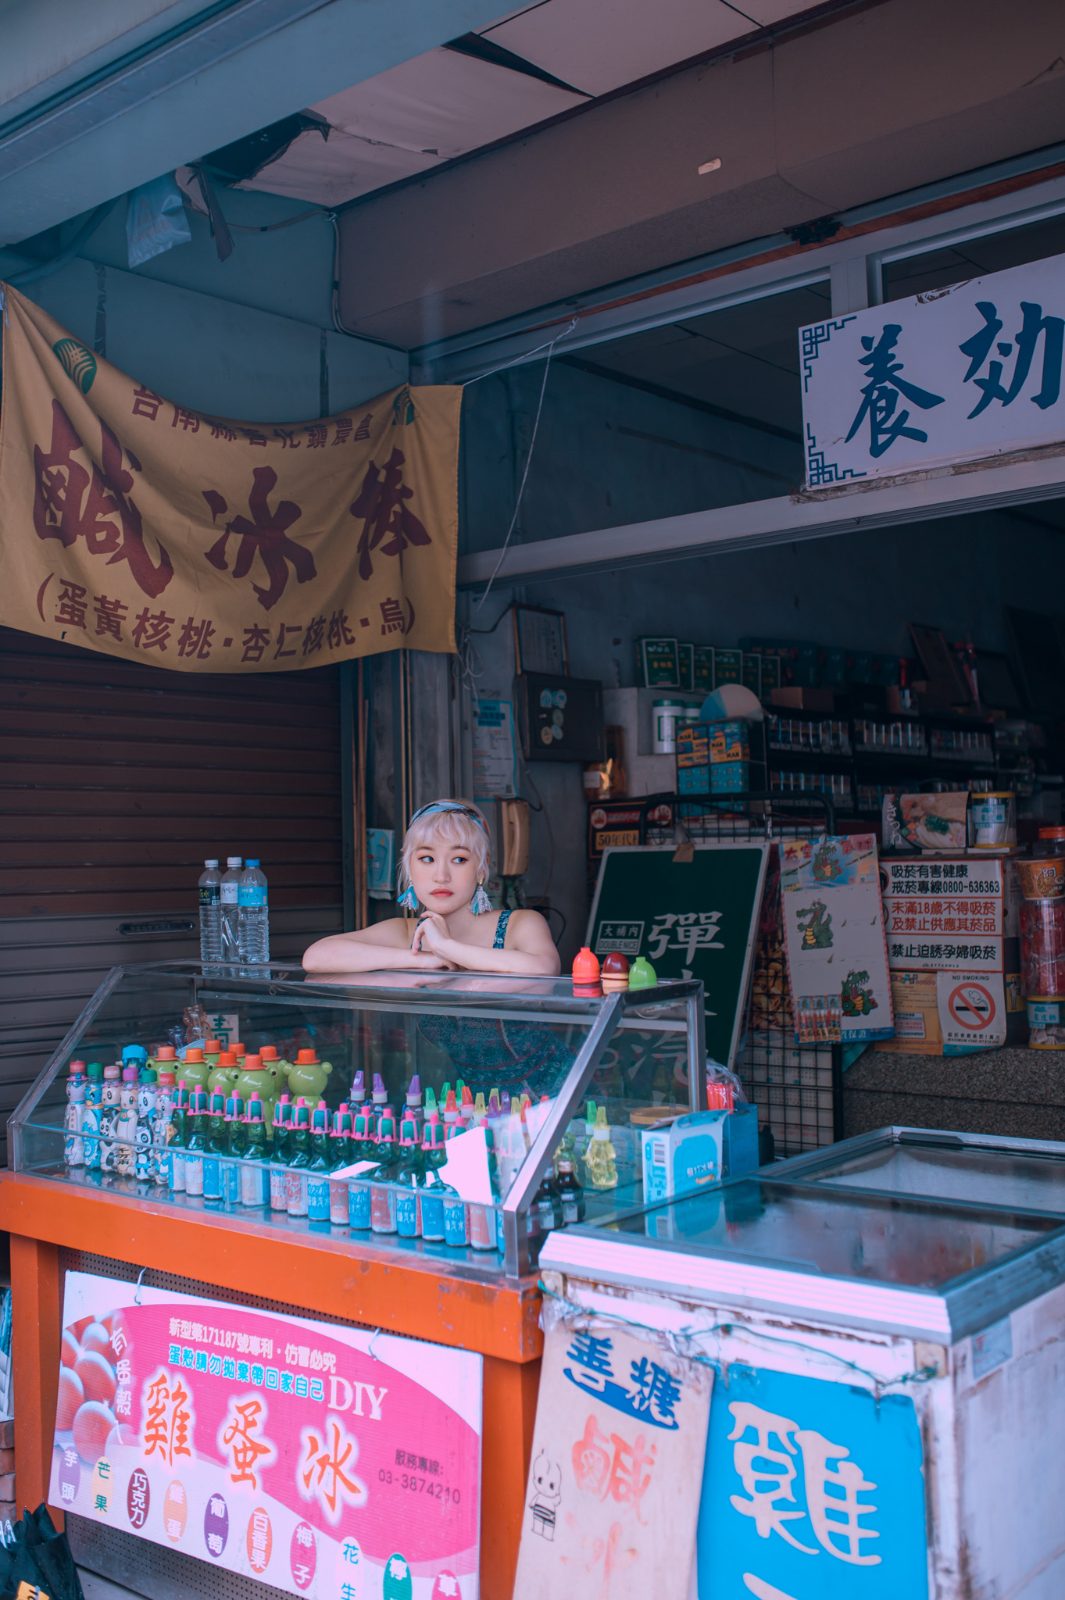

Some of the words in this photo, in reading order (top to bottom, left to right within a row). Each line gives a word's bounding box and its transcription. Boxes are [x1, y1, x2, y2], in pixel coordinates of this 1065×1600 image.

[891, 864, 968, 878] 吸菸有害健康
[892, 880, 1000, 894] 戒菸專線0800-636363
[892, 901, 996, 915] 未滿18歲不得吸菸
[892, 917, 996, 932] 及禁止供應其菸品
[891, 944, 996, 960] 禁止迫誘孕婦吸菸
[329, 1374, 388, 1421] DIY
[144, 1374, 365, 1512] 雞蛋冰
[61, 1449, 79, 1502] 芋頭
[93, 1461, 111, 1513] 芒果
[130, 1471, 148, 1526] 巧克力
[378, 1469, 461, 1505] 03-3874210
[207, 1497, 226, 1554] 葡萄
[250, 1511, 269, 1569] 百香果
[293, 1525, 313, 1585] 梅子
